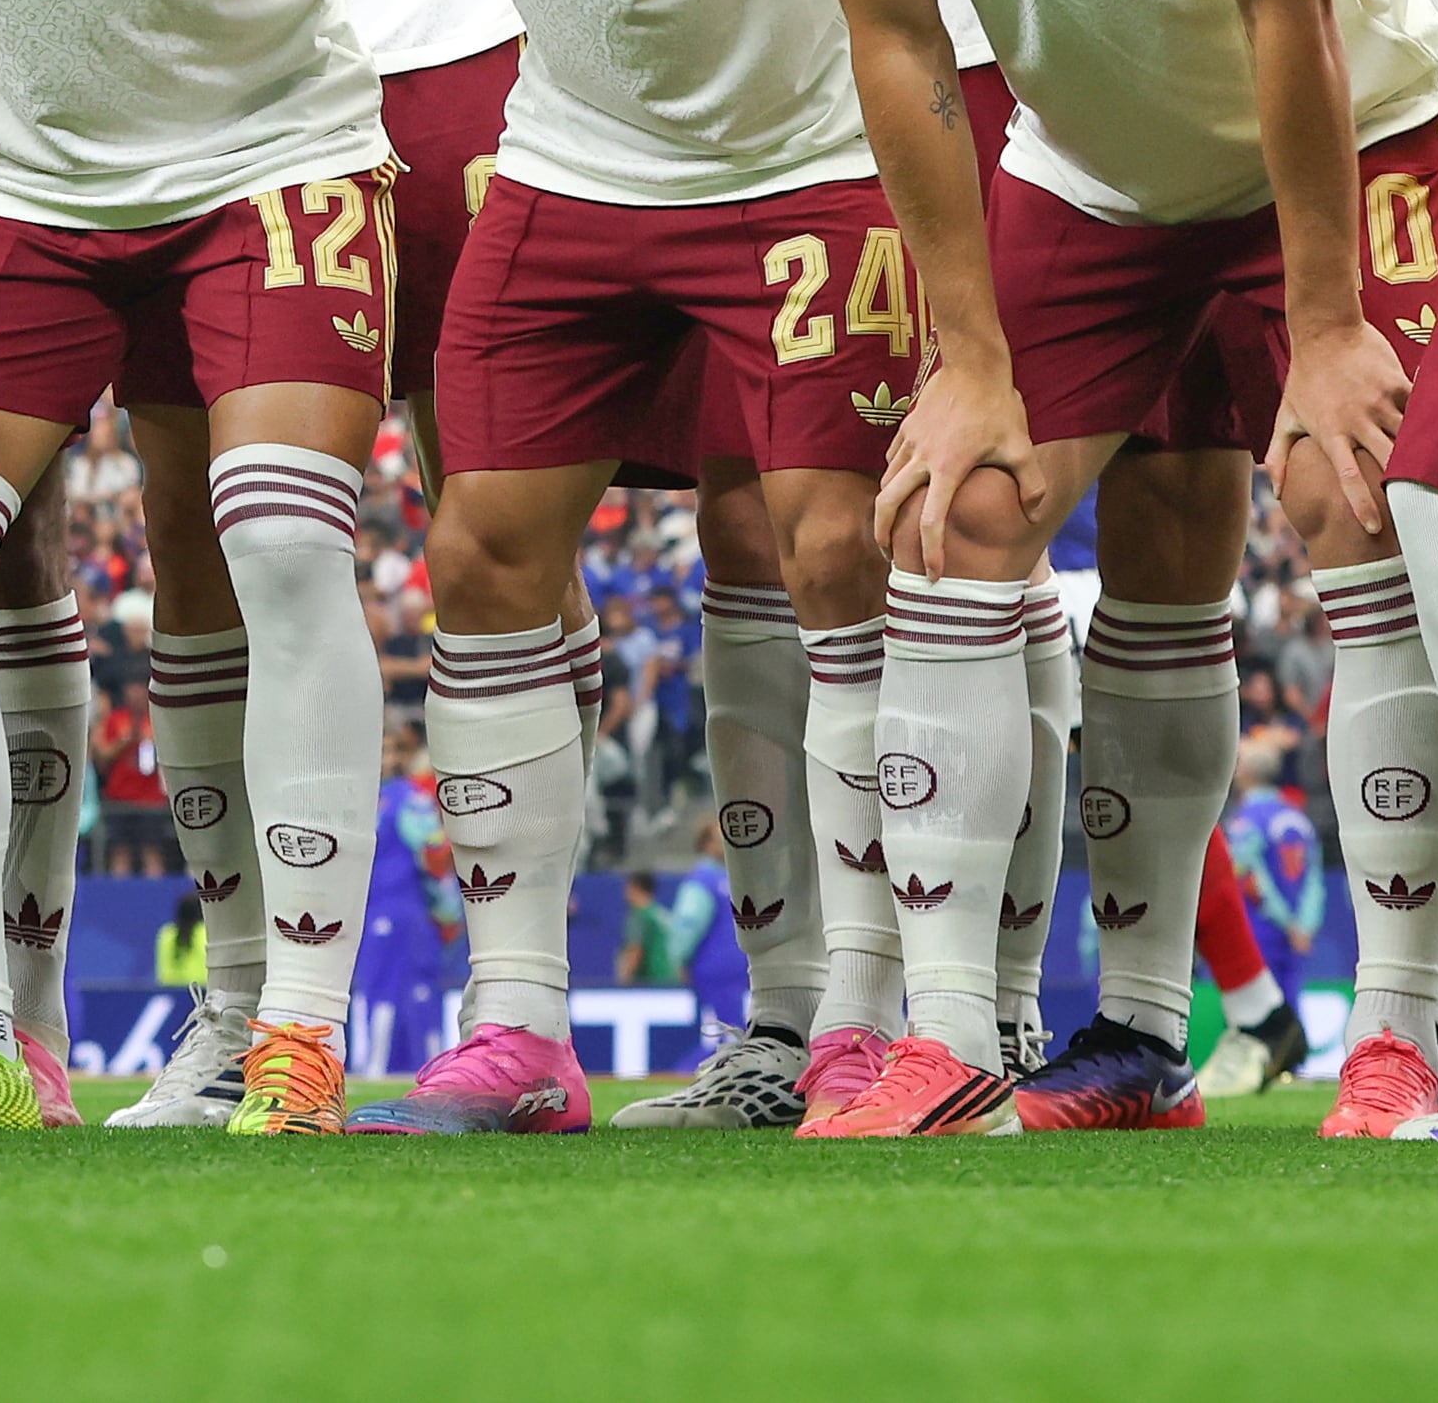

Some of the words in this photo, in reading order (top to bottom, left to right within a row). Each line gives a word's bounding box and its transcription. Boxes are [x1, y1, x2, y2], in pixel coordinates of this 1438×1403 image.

[248, 178, 372, 296] 12
[763, 225, 912, 366] 24
[882, 764, 918, 780] RF
[444, 783, 486, 795] RF
[884, 781, 919, 797] EF
[1374, 778, 1414, 793] RF
[182, 794, 212, 808] RF
[447, 794, 487, 807] EF
[1084, 797, 1112, 812] RF
[1375, 794, 1413, 809] EF
[182, 807, 213, 821] EF
[726, 809, 758, 824] RF
[1086, 812, 1113, 829] EF
[277, 831, 316, 847] RF
[729, 824, 759, 839] EF
[281, 845, 318, 858] EF
